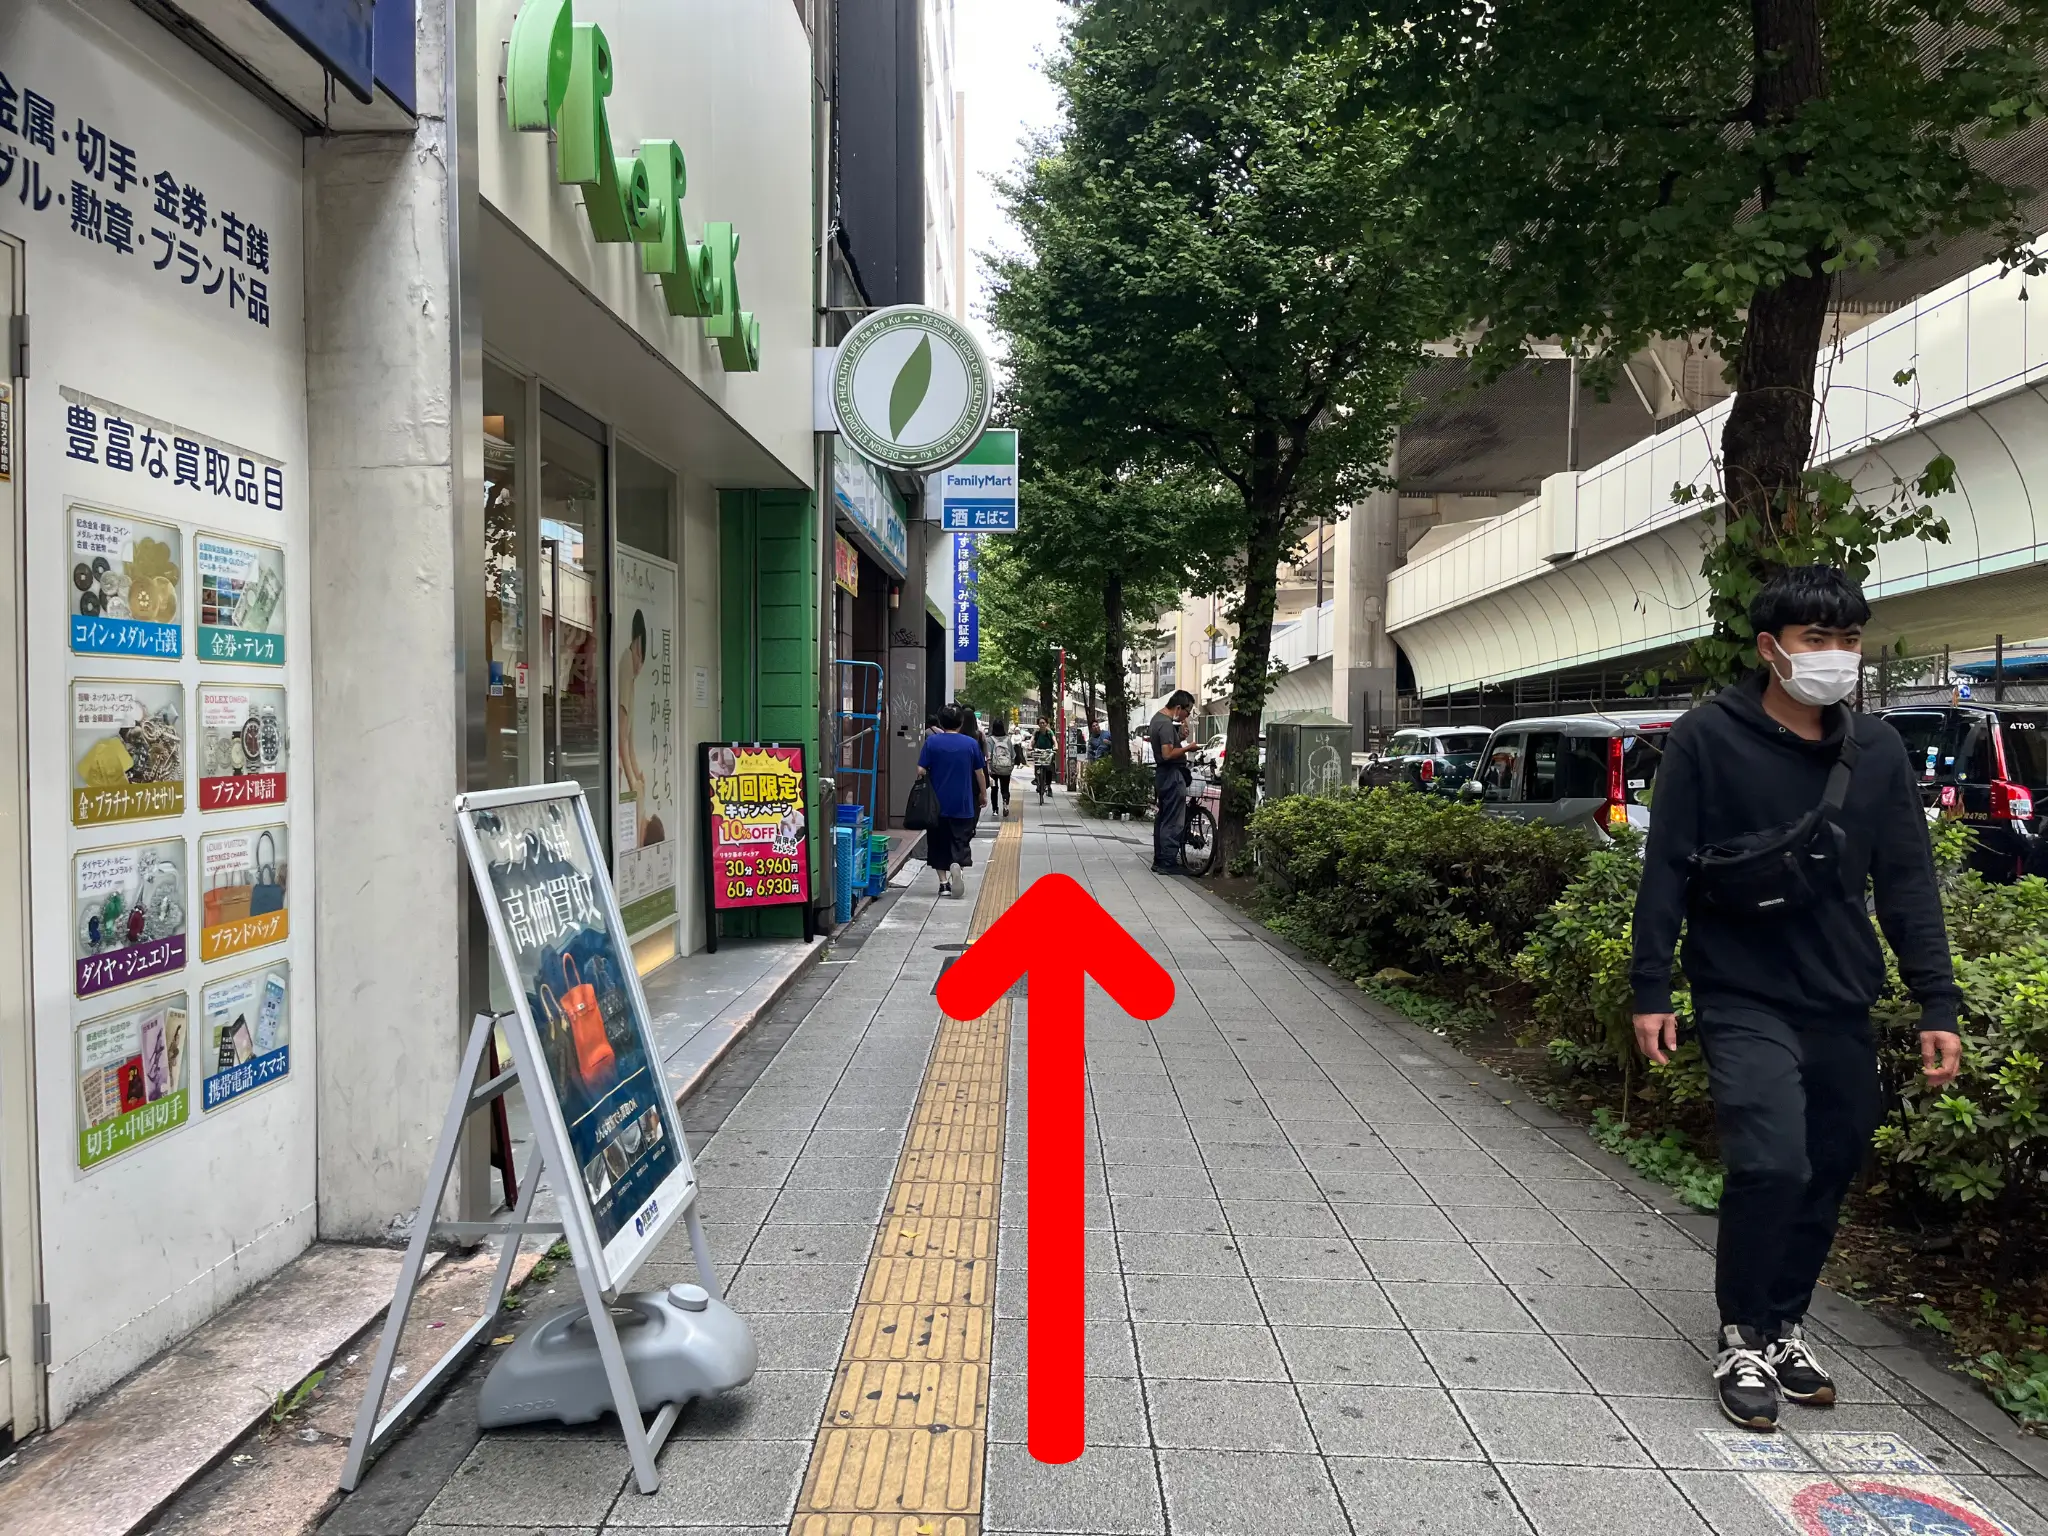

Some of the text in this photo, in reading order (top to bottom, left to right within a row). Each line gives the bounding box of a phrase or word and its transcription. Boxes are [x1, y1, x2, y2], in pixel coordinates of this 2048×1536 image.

[921, 315, 953, 335] DESIGN
[848, 340, 862, 358] LIFE
[951, 332, 976, 361] STUDIO
[838, 357, 851, 399] HEALTHY
[971, 362, 981, 375] OF
[840, 399, 850, 413] OF
[971, 376, 983, 419] HEALTHY
[848, 414, 869, 442] STUDIO
[960, 418, 973, 436] LIFE
[65, 404, 284, 511] 豊富な買取品目
[868, 441, 899, 459] DESIGN
[947, 475, 1012, 488] FamilyMart
[951, 508, 1009, 527] 酒 たばこ
[958, 532, 970, 647] ずほ銀行 みずほ証券
[76, 621, 178, 654] コイン・メダル・古銭
[211, 631, 274, 659] 金券・テレカ
[204, 694, 228, 704] ROLEX
[211, 779, 276, 803] ブランド時計
[717, 774, 799, 803] 初回限定
[78, 786, 183, 820] 金・プラチナ・アクセサリー
[725, 803, 793, 818] キャンペーン
[499, 823, 572, 874] ブランド品
[726, 859, 753, 877] 30分
[726, 880, 754, 898] 60分
[502, 871, 602, 954] 高価買取
[211, 915, 281, 952] ブランドバッグ
[81, 943, 183, 988] ダイヤ・ジュエリー
[208, 1052, 286, 1104] 携帯電話・スマホ
[86, 1095, 183, 1158] 切手・中国切手
